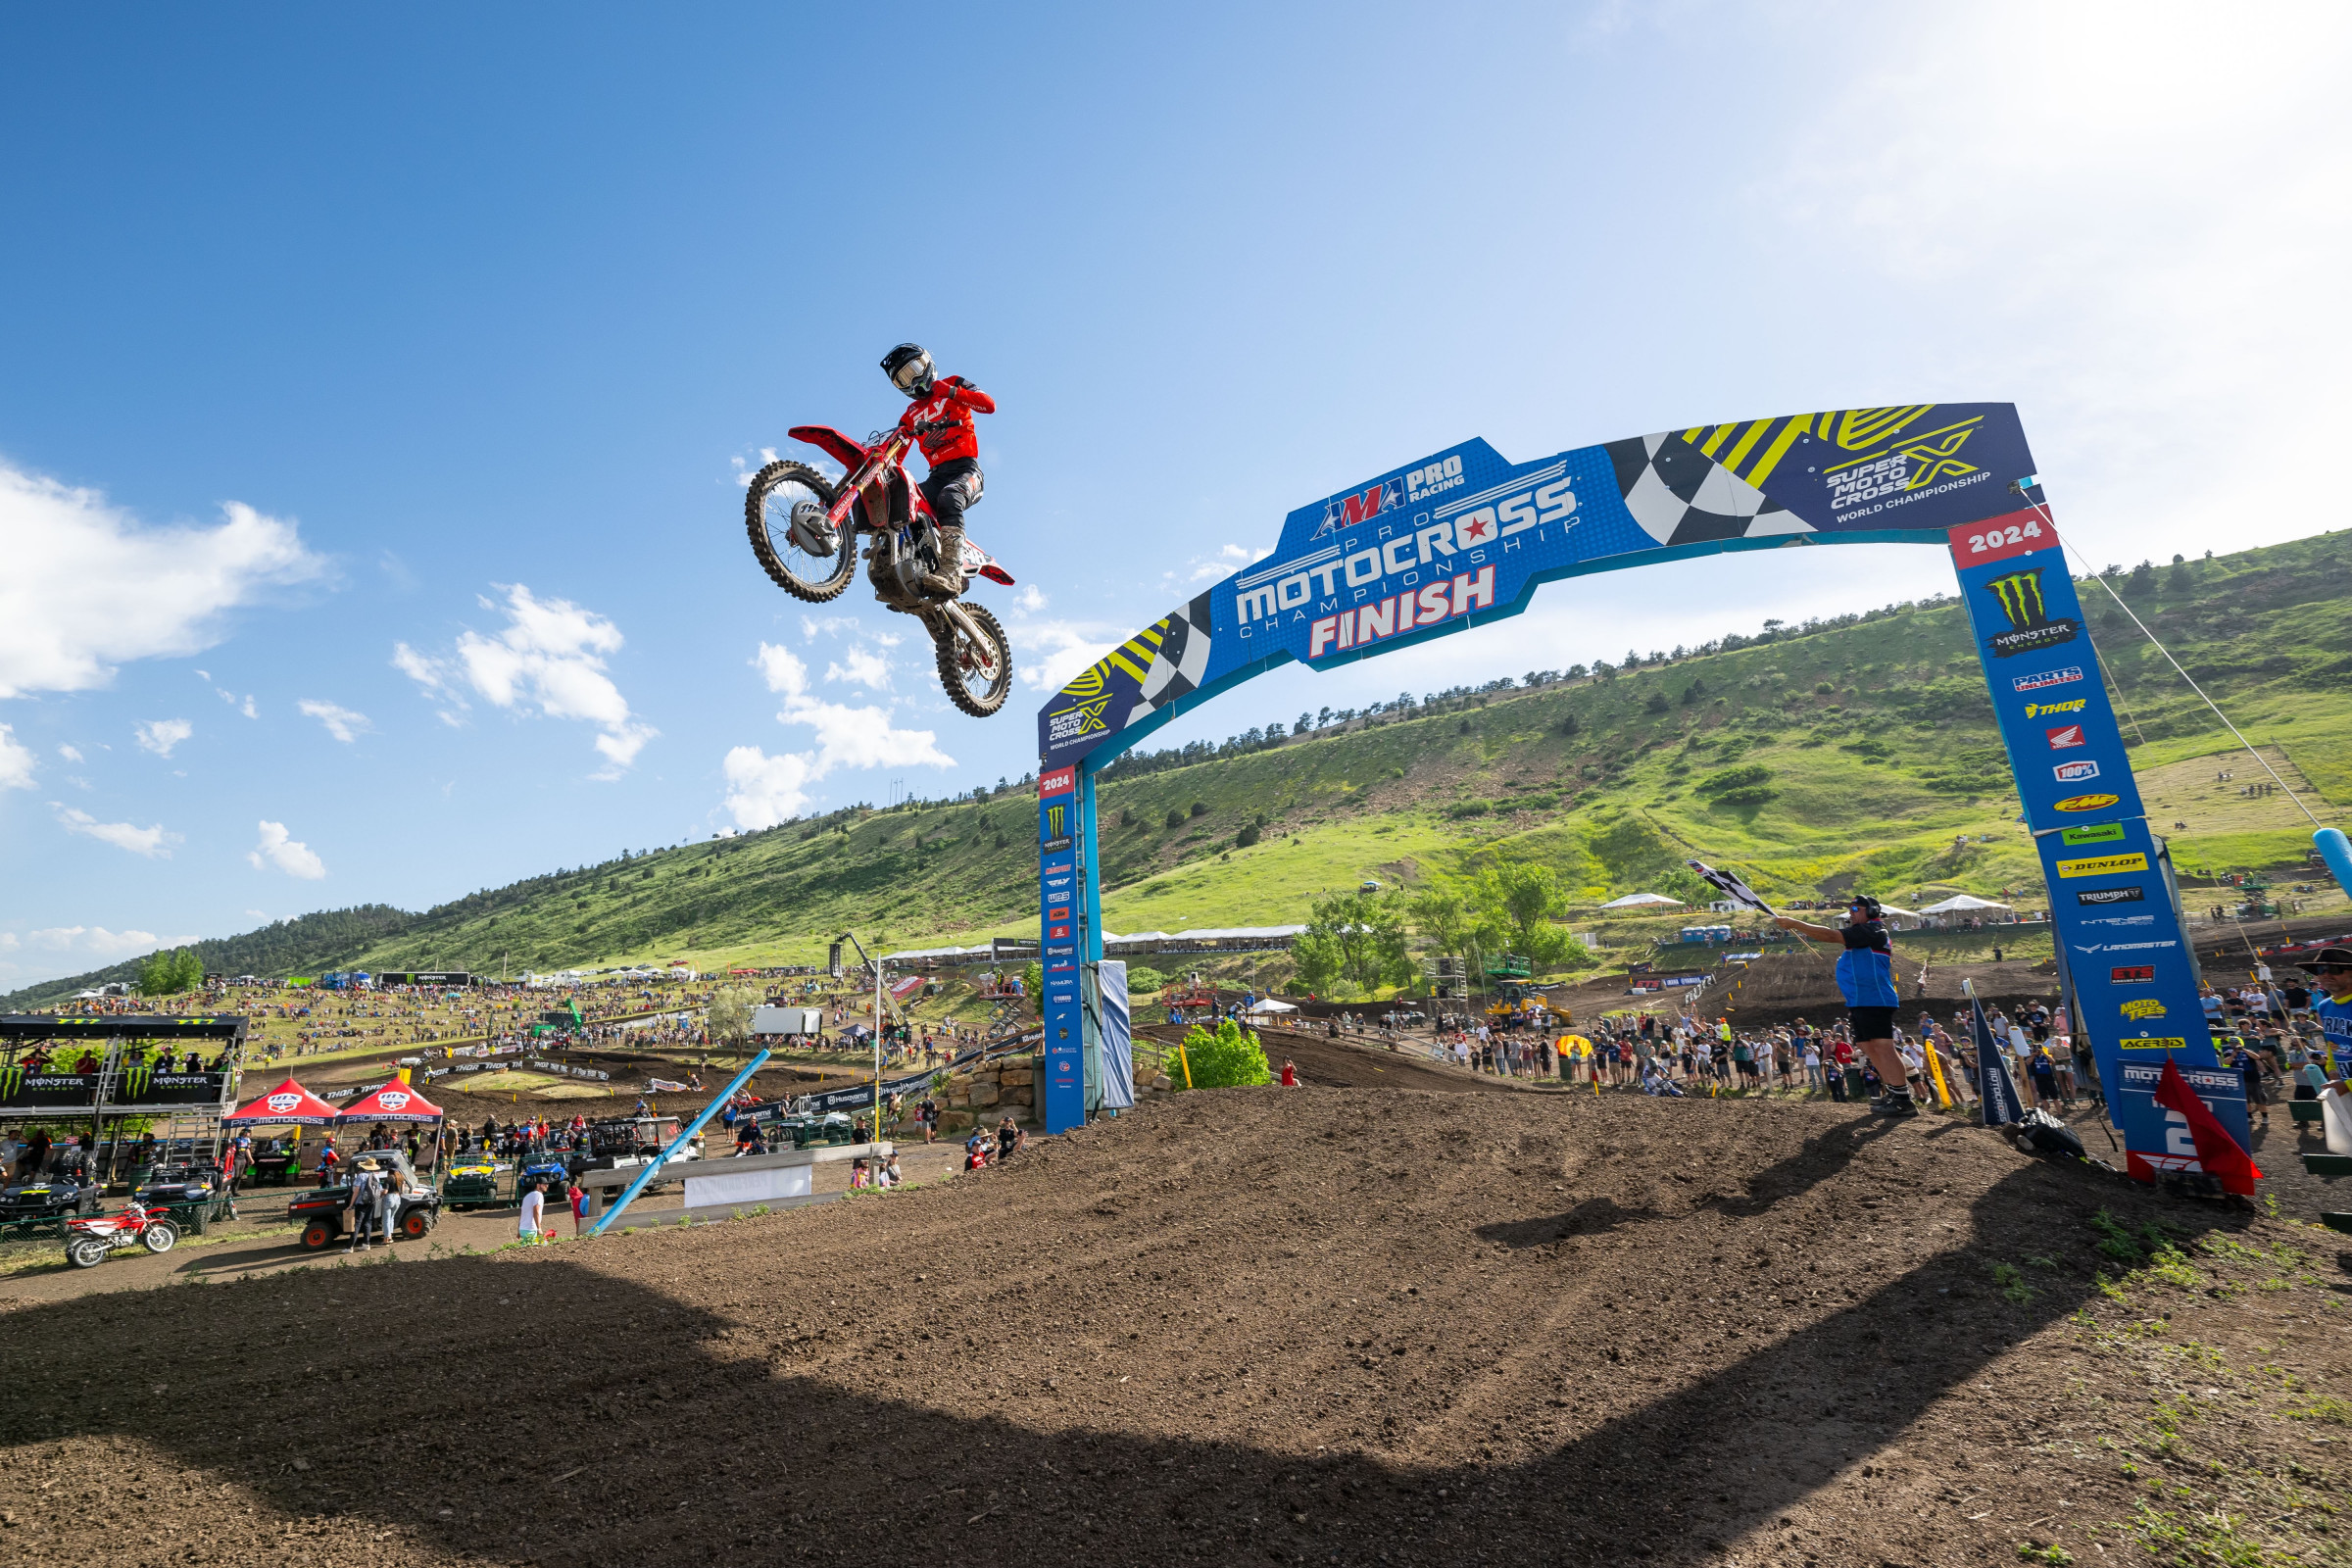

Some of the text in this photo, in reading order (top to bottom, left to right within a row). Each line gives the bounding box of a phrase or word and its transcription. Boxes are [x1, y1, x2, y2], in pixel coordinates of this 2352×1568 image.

[1407, 454, 1464, 492] PRO
[1826, 454, 1908, 488] SUPER
[1409, 474, 1464, 504] RACING
[1835, 466, 1906, 497] MOTO
[1831, 478, 1910, 510] CROSS
[1836, 471, 1991, 523] WORLD CHAMPIONSHIP
[833, 491, 854, 516] DUNLOP
[1309, 476, 1406, 541] AMA
[1345, 512, 1430, 553] PRO
[1968, 520, 2042, 554] 2024
[1237, 476, 1577, 624] MOTOCROSS
[1240, 516, 1581, 639] CHAMPIONSHIP
[1309, 564, 1496, 660] FINISH
[1996, 623, 2070, 647] MONSTER
[2009, 636, 2059, 651] ENERGY
[2014, 667, 2081, 687] PARTS
[2016, 674, 2082, 692] UNLIMITED
[2039, 699, 2086, 715] THOR
[1050, 710, 1084, 726] SUPER
[1052, 718, 1081, 734] MOTO
[1050, 726, 1081, 741] CROSS
[1051, 728, 1111, 751] WORLD CHAMPIONSHIP
[2052, 741, 2083, 750] HONDA
[2060, 763, 2093, 779] 100%
[1043, 774, 1069, 791] 2024
[2069, 828, 2117, 840] Kawasaki
[2075, 858, 2142, 871] DUNLOP
[2079, 890, 2129, 902] TRIUMPH
[2102, 940, 2177, 952] LANDMASTER
[2112, 965, 2154, 979] ETS
[2120, 999, 2160, 1014] MOTO
[2129, 1005, 2167, 1021] TEES
[24, 1077, 84, 1086] MONSTER
[153, 1076, 208, 1085] MONSTER
[327, 1088, 354, 1099] THOR
[836, 1092, 869, 1103] Husqvarna
[737, 1109, 771, 1121] Husqvarna
